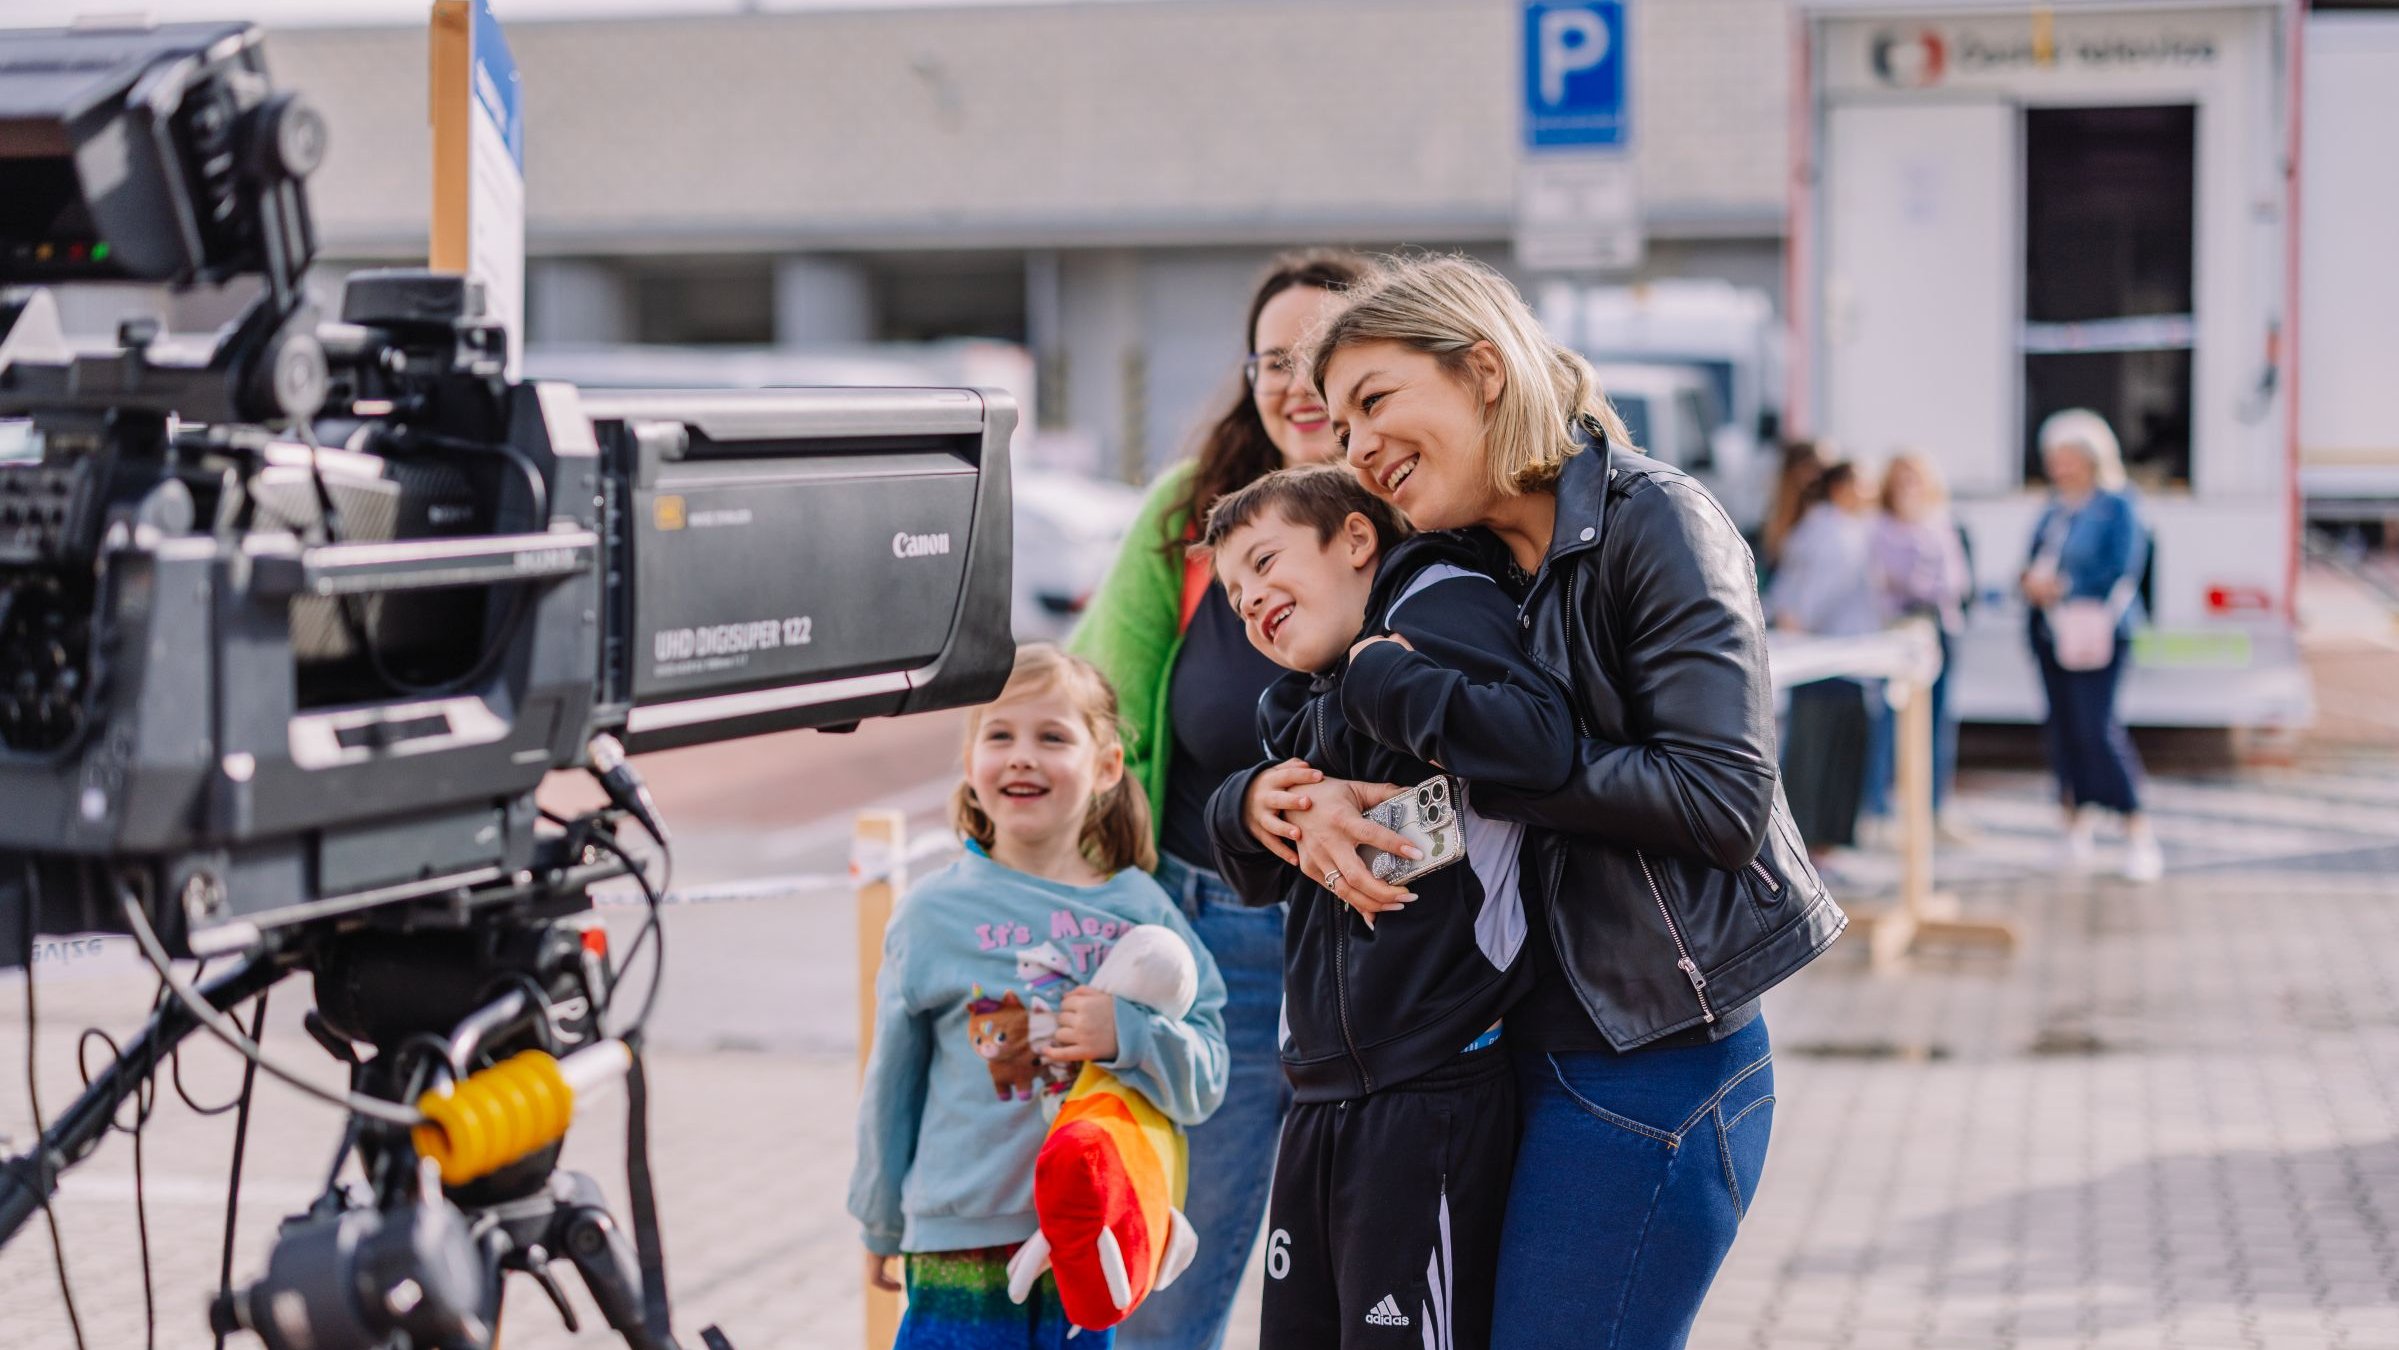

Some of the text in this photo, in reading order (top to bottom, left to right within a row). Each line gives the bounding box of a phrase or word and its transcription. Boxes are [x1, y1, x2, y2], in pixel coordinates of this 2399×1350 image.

[1539, 8, 1612, 106] P
[892, 531, 950, 559] Canon
[654, 615, 812, 662] UHD DIGISUPER 122
[975, 920, 1032, 951] It's
[1267, 1228, 1292, 1280] 6
[1365, 1313, 1410, 1326] adidas
